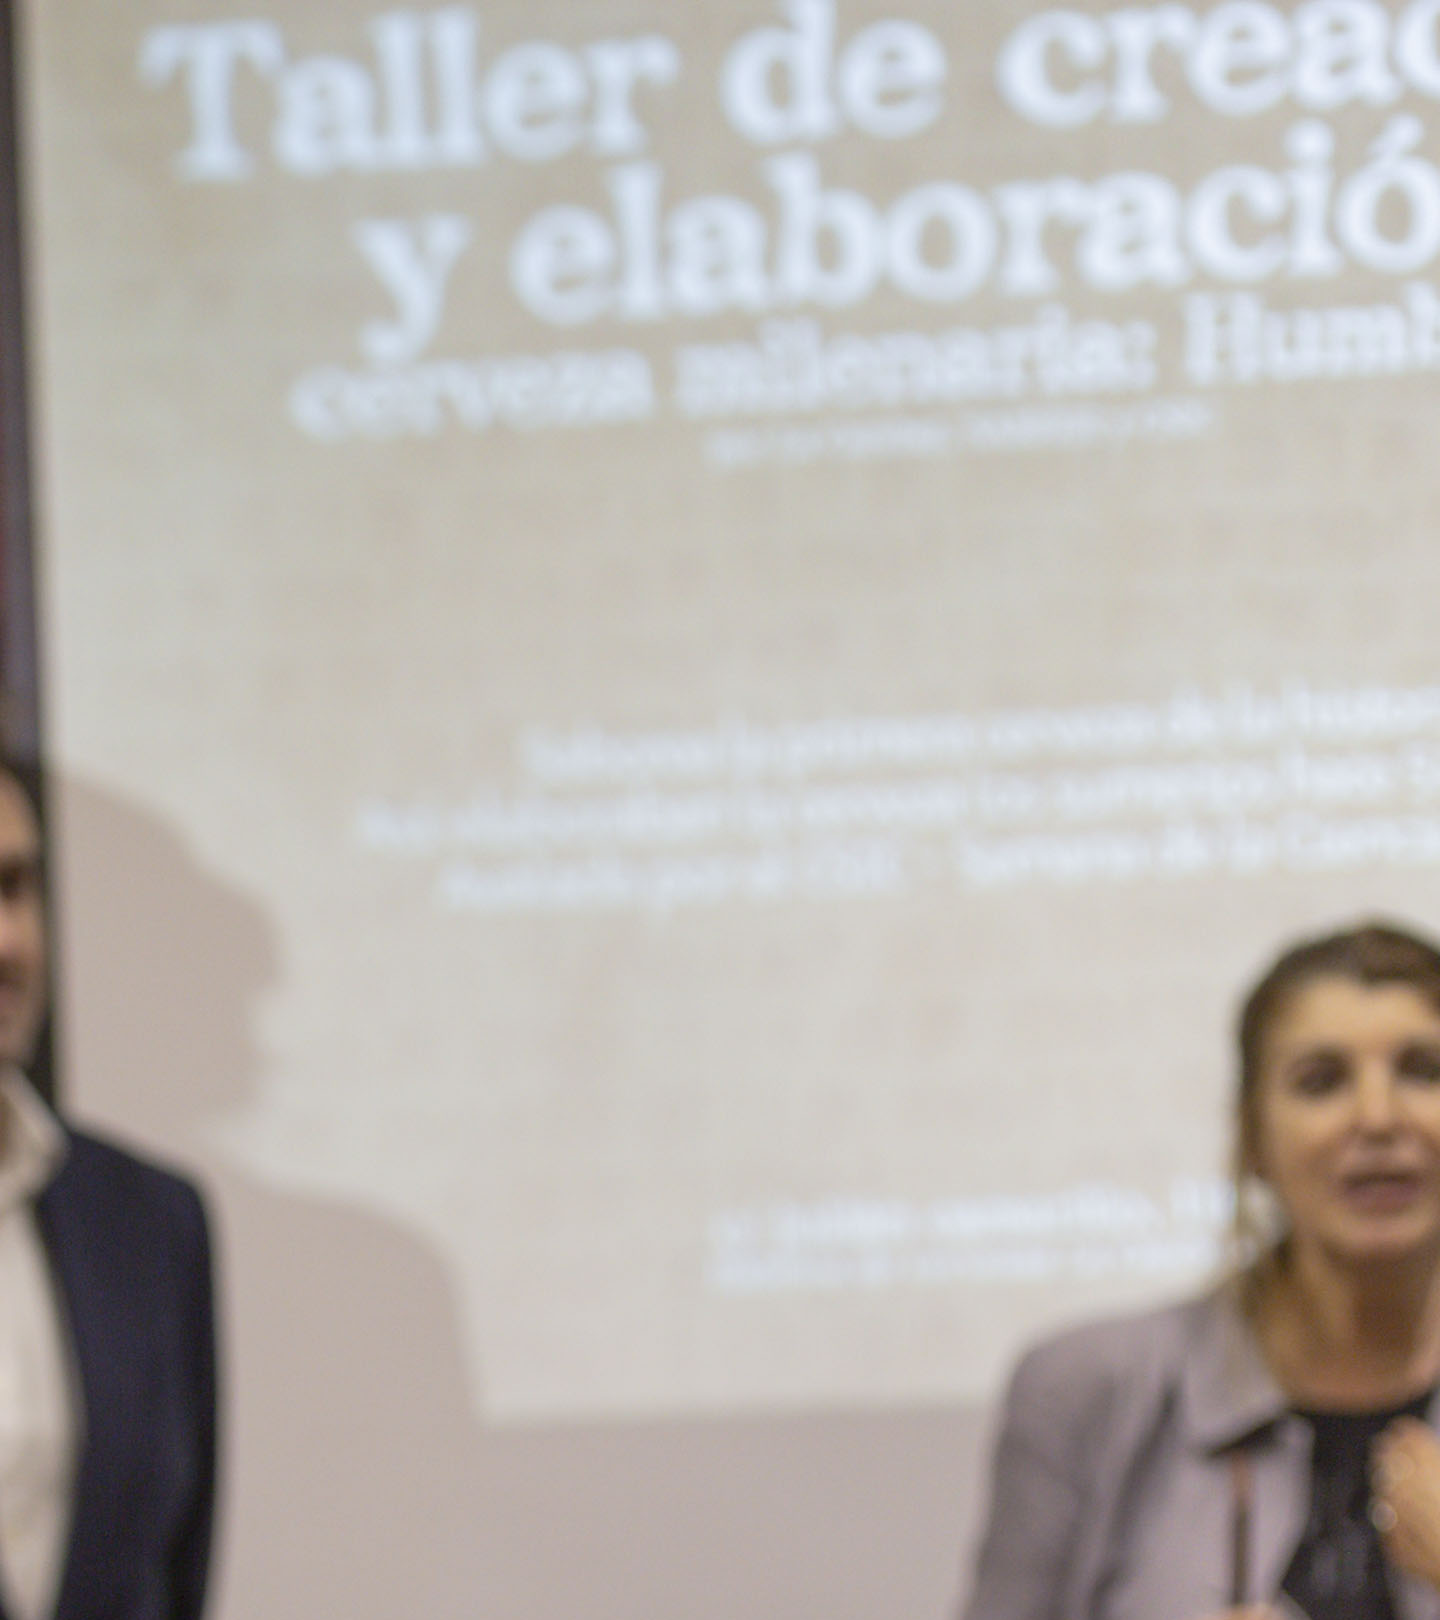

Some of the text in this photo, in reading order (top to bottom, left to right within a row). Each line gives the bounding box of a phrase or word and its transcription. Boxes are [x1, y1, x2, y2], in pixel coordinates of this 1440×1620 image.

[138, 14, 678, 182] Taller
[718, 0, 948, 144] de
[355, 114, 1440, 364] y elaboració
